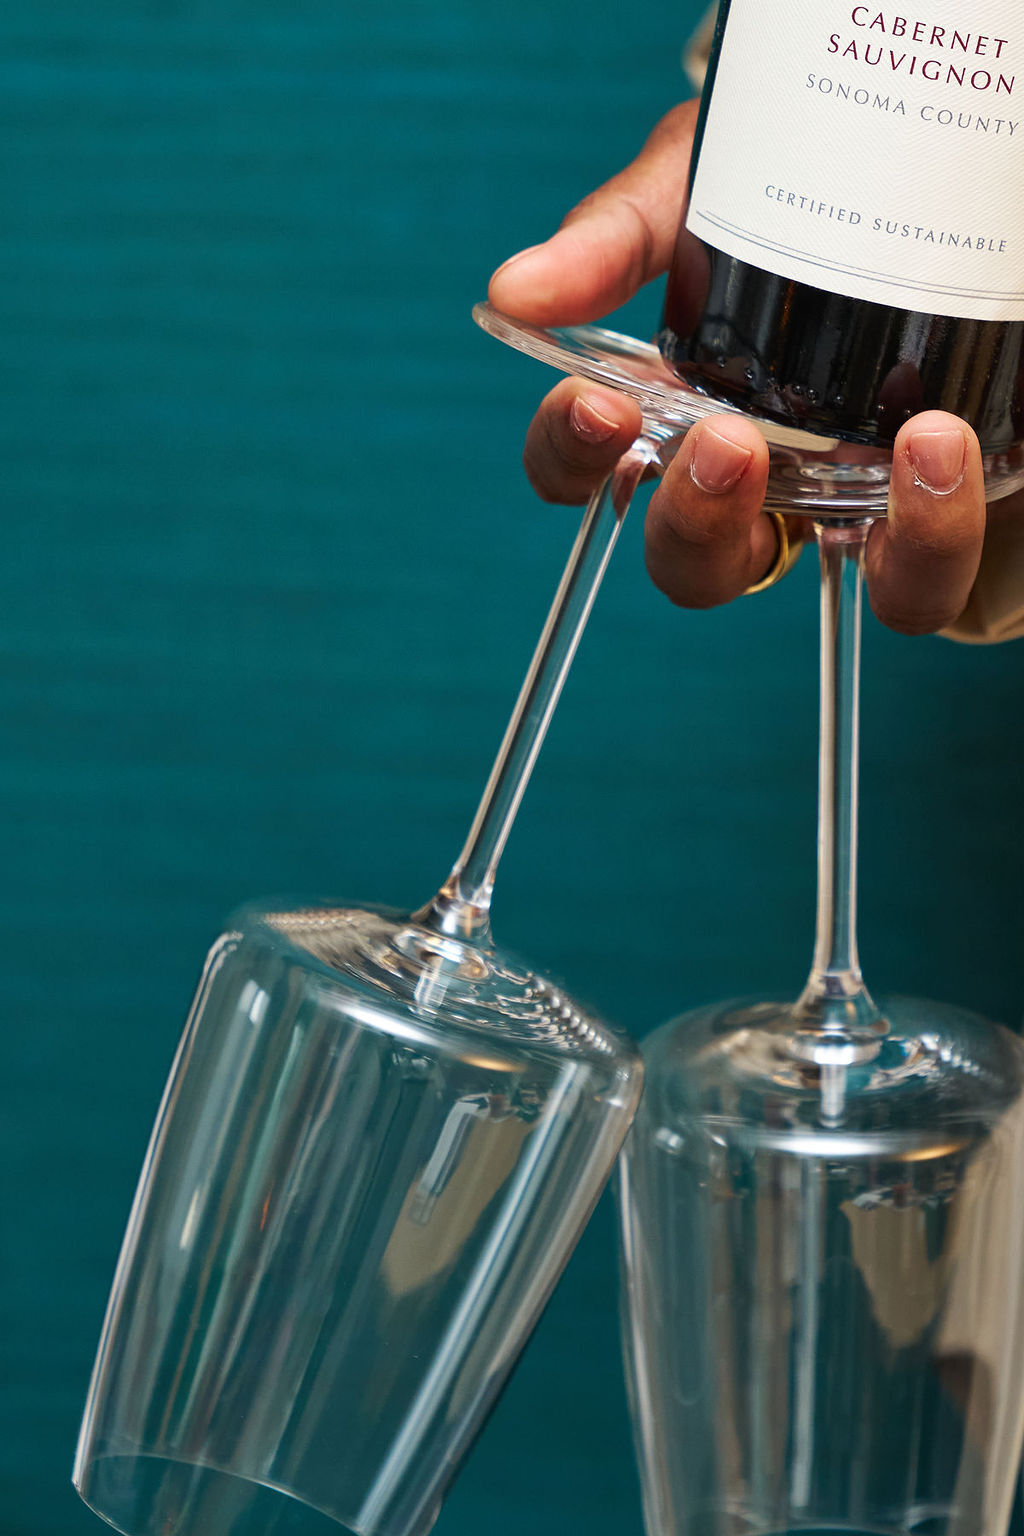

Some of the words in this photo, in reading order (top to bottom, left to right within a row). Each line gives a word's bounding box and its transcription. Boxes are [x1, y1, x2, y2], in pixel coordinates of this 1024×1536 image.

[851, 5, 1009, 59] CABERNET
[826, 33, 1016, 95] SAUVIGNON
[805, 73, 906, 116] SONOMA
[919, 105, 1019, 136] COUNTY
[765, 184, 862, 225] CERTIFIED
[872, 218, 1007, 253] SUSTAINABLE
